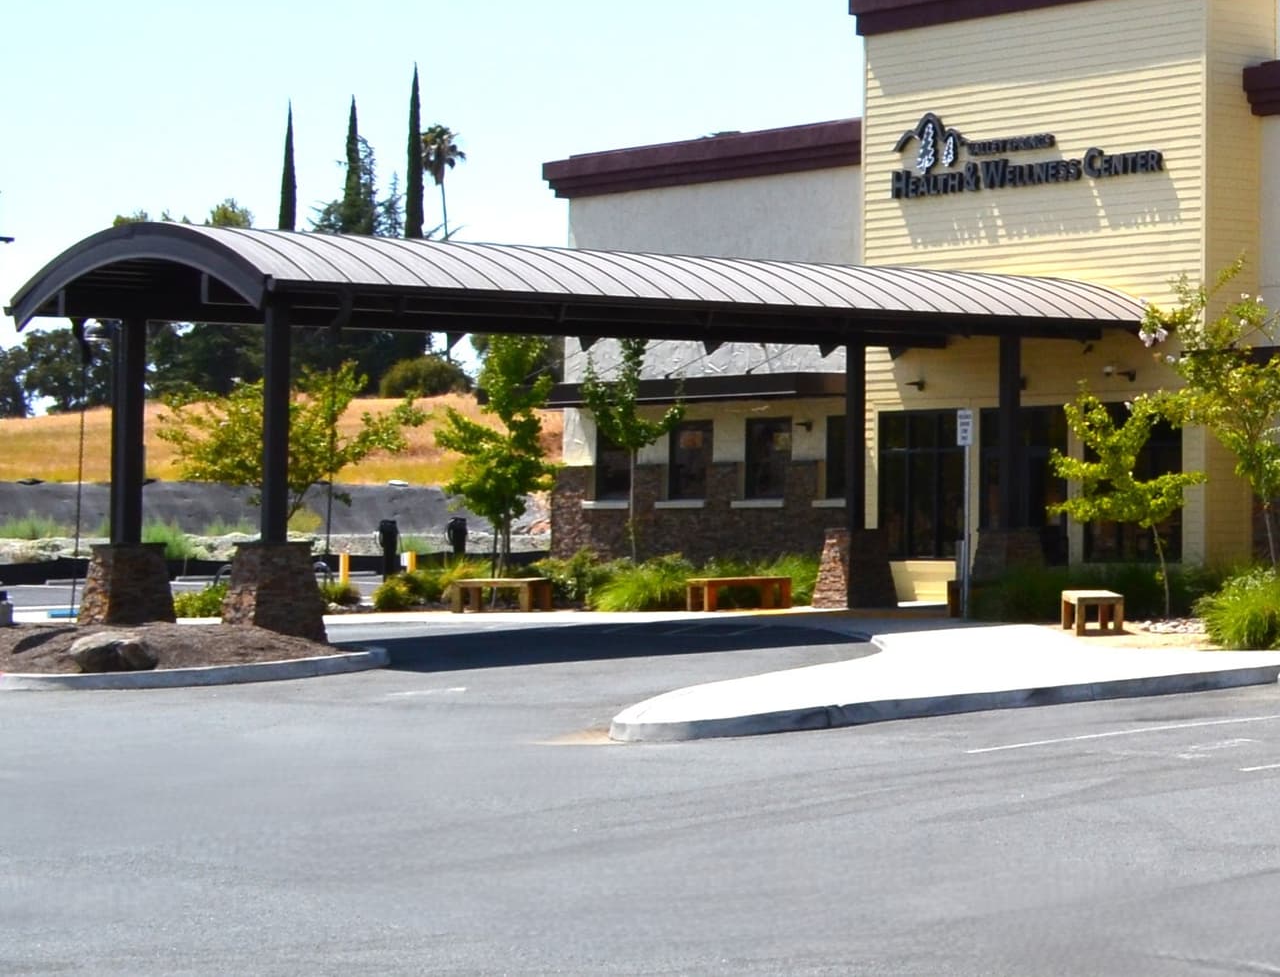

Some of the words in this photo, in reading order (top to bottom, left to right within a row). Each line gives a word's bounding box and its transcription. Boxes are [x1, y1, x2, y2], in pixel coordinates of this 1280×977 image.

[891, 171, 964, 199] HEALTH
[963, 162, 981, 191] &
[980, 158, 1082, 190] WELLNESS
[1083, 146, 1164, 179] CENTER
